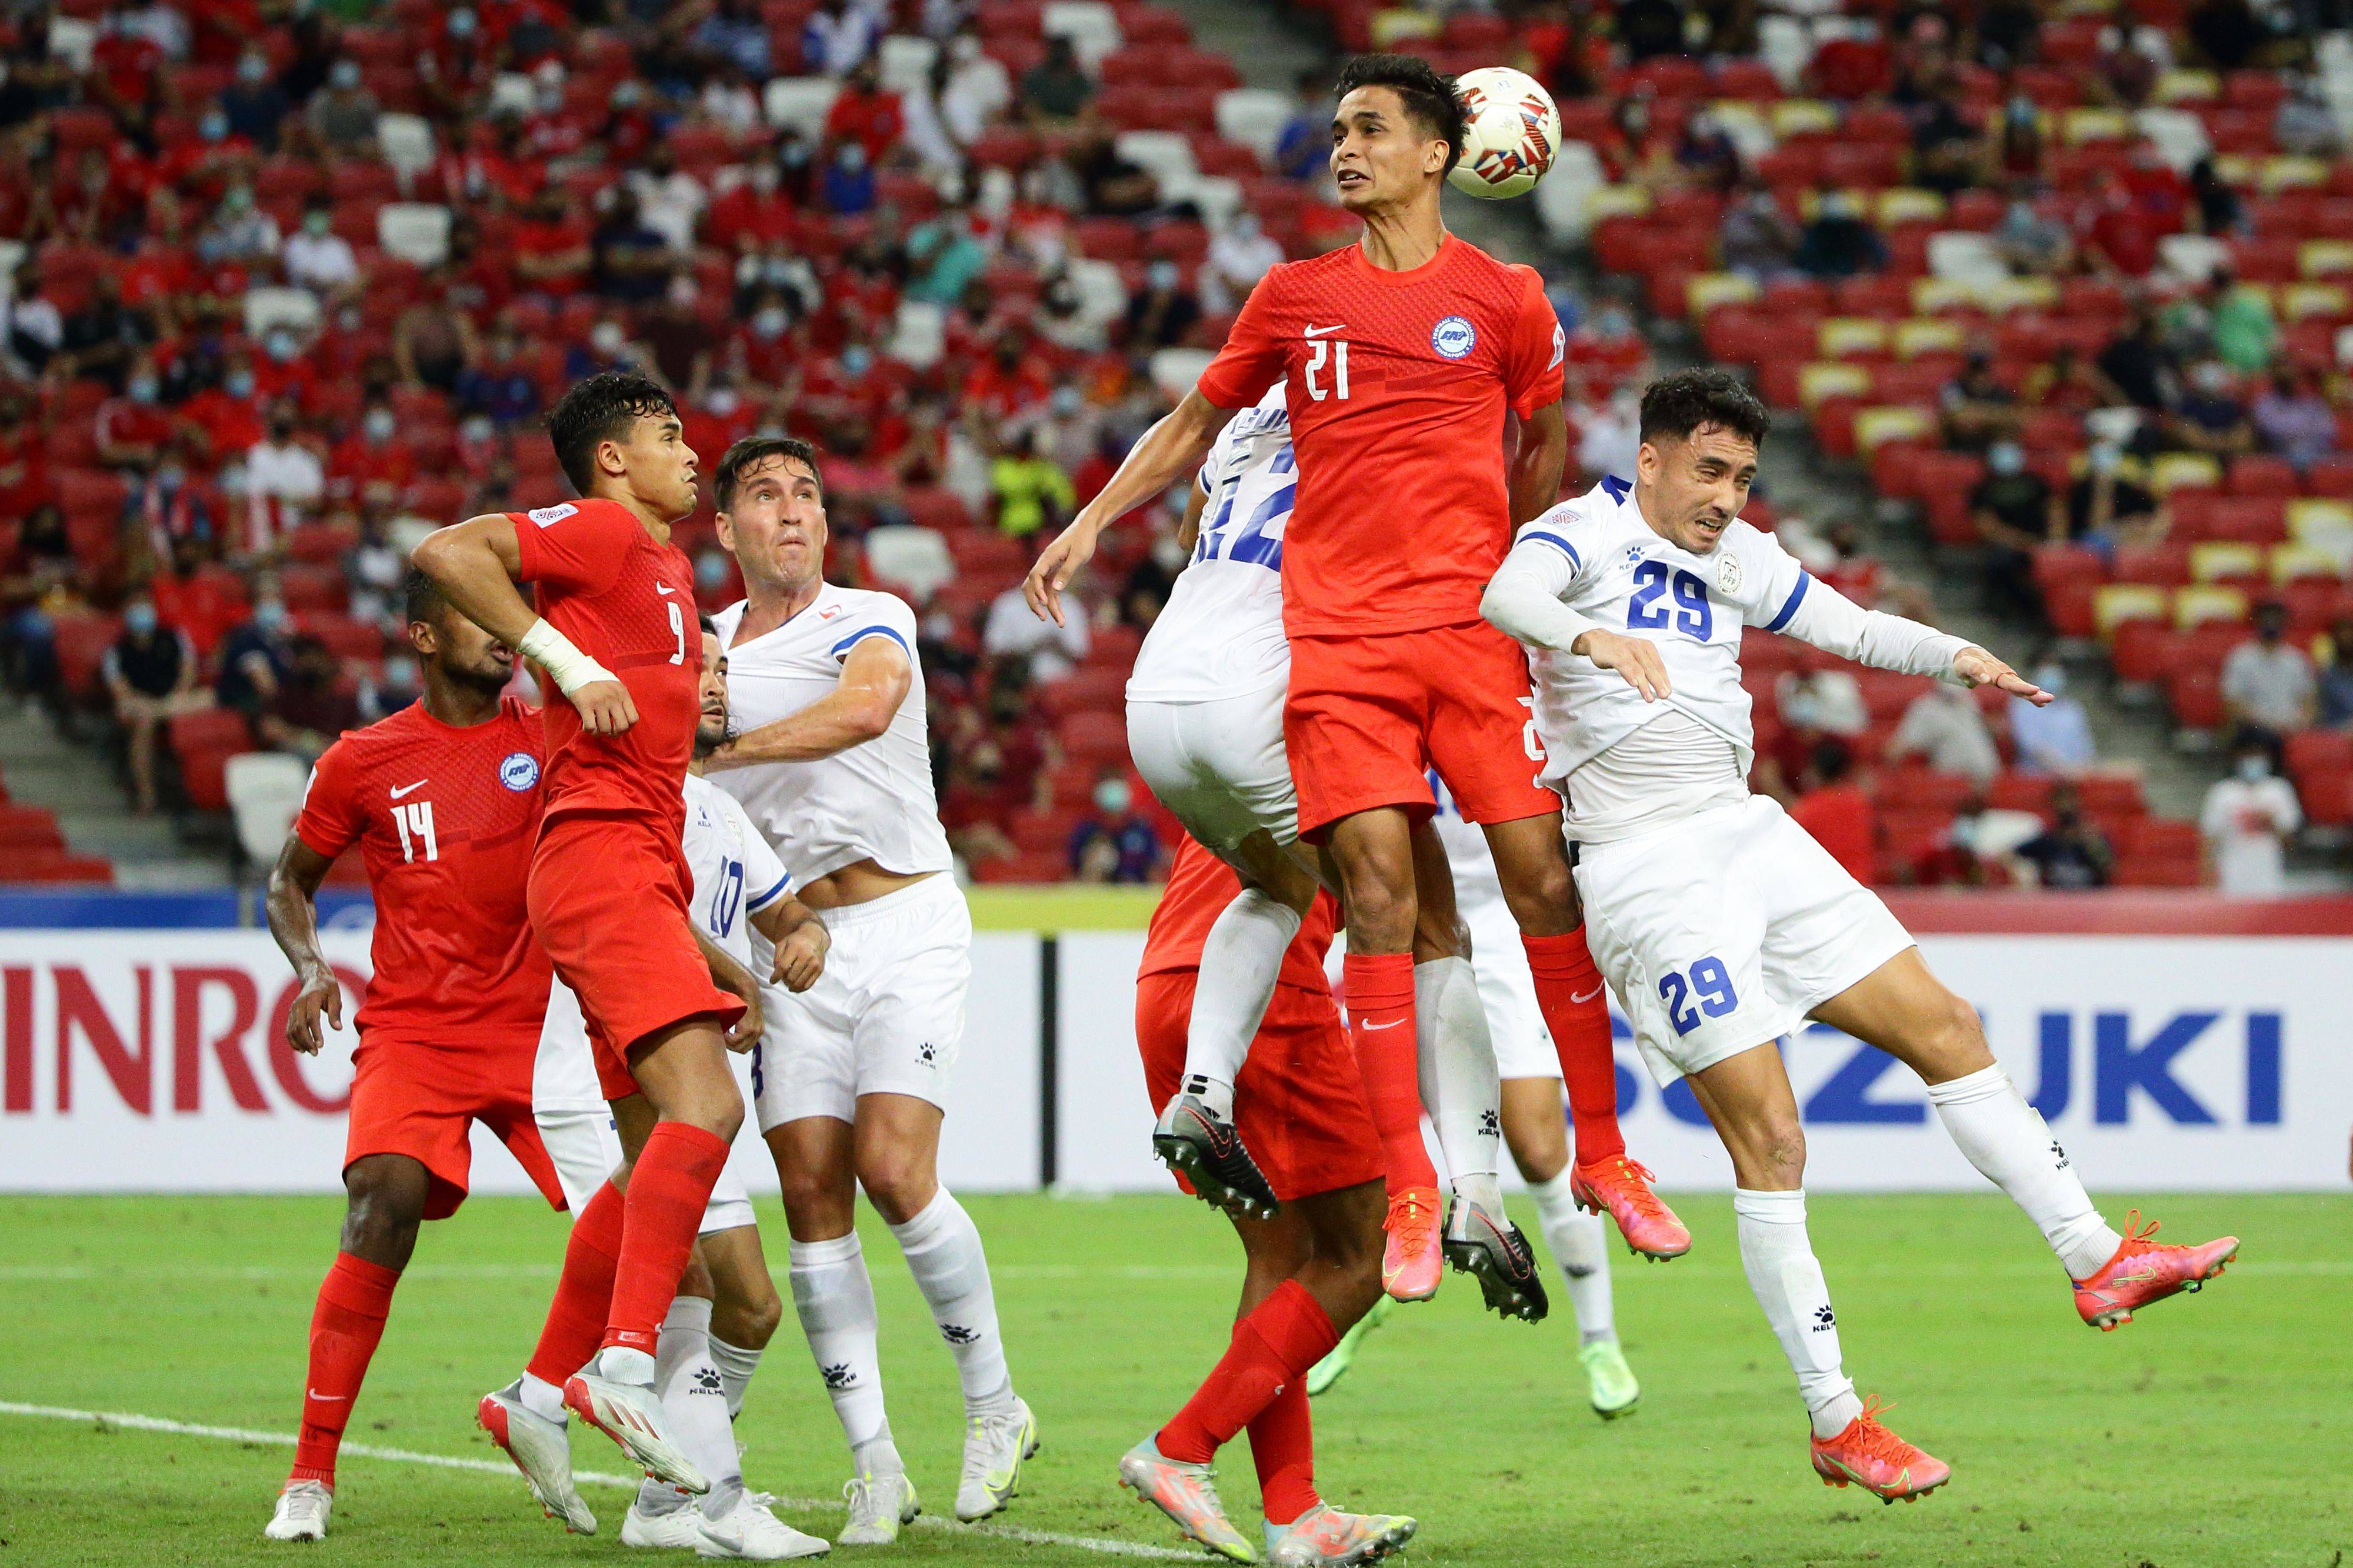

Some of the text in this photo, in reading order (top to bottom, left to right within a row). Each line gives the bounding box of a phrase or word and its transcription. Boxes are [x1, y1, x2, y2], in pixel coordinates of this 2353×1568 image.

[1432, 317, 1475, 346] FOOTBALL ASSOCIATION
[1435, 346, 1467, 358] SINGAPORE
[1305, 340, 1349, 401] 21
[1627, 560, 1712, 643] 29
[1722, 573, 1737, 586] PFF
[667, 601, 685, 666] 9
[389, 801, 438, 864] 14
[710, 855, 744, 939] 10
[1658, 955, 1738, 1038] 29
